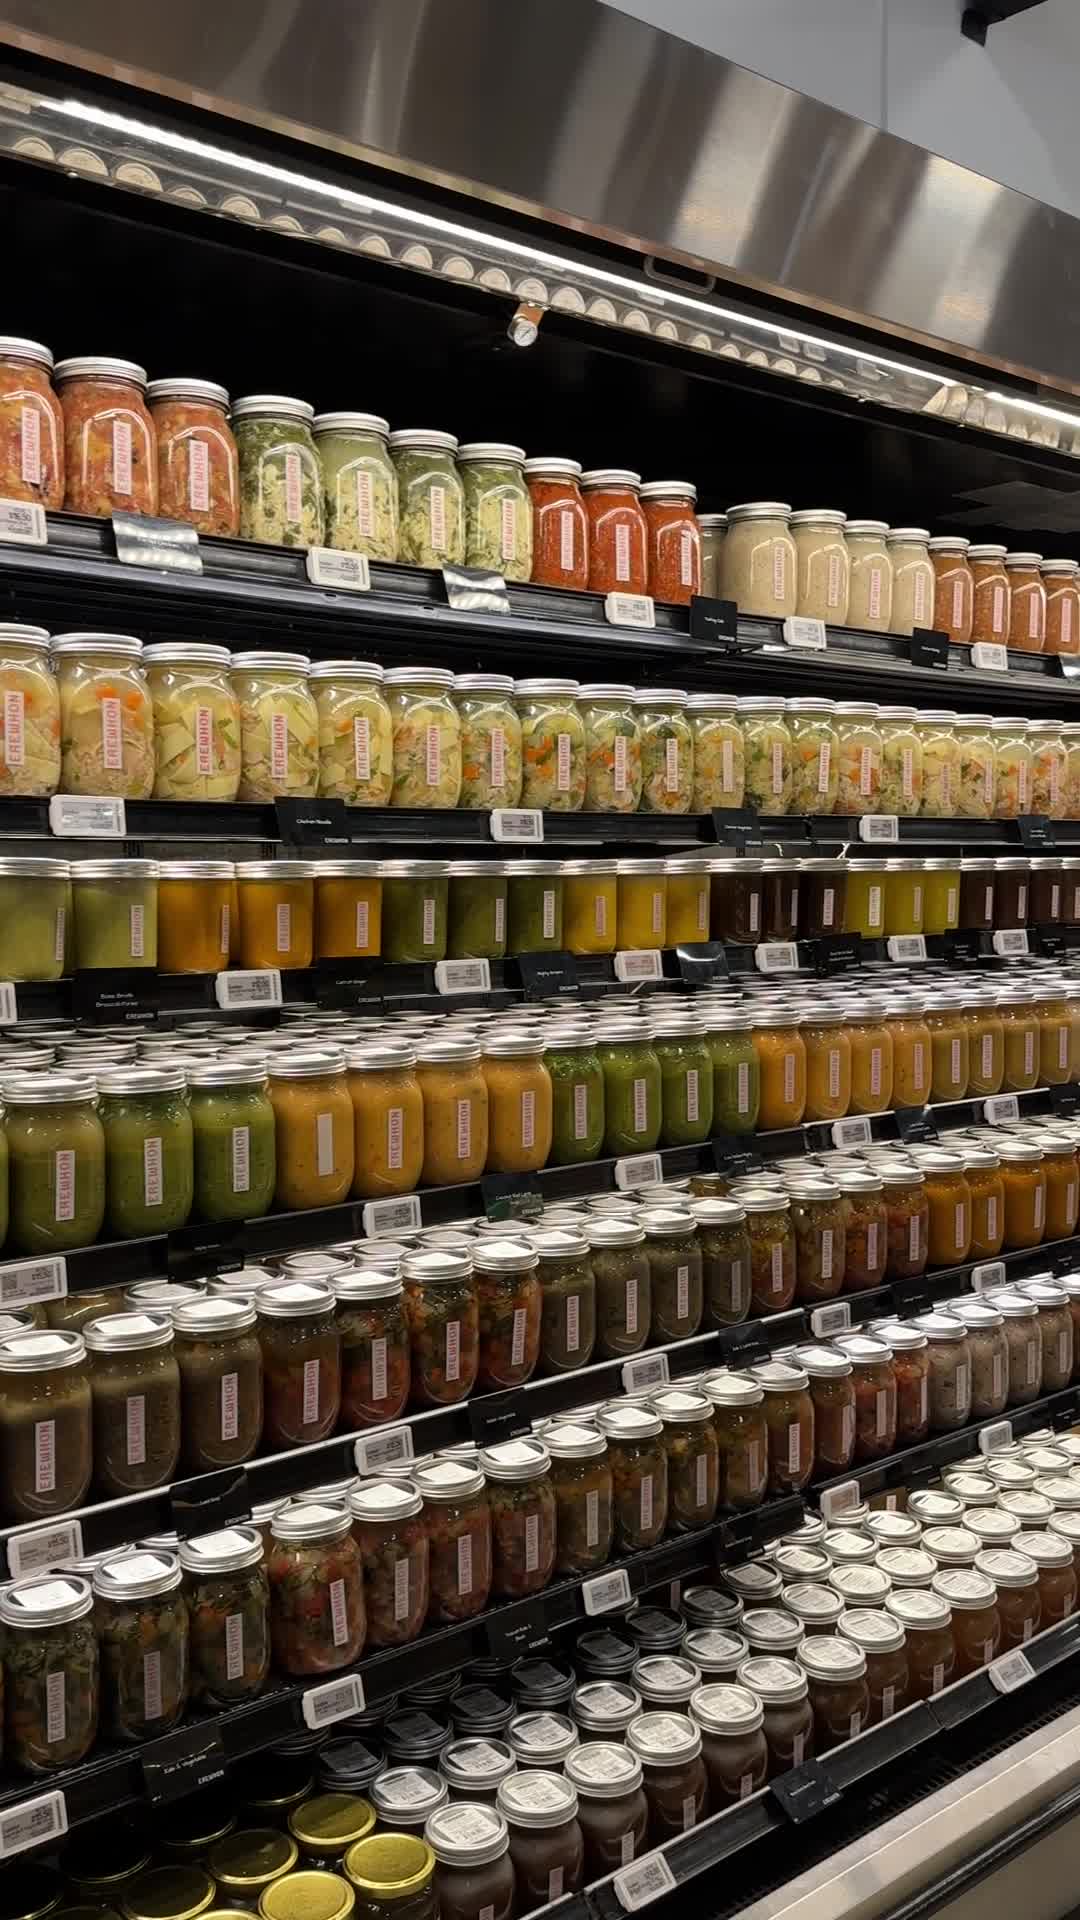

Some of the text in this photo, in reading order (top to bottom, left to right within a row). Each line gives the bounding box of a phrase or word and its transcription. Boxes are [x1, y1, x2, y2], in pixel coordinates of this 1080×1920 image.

[115, 422, 130, 493] EREWHON
[191, 441, 206, 509] EREWHON
[288, 456, 300, 520] EREWHON
[359, 472, 371, 535] EREWHON
[433, 488, 443, 548] EREWHON
[504, 500, 513, 558] EREWHON
[7, 694, 22, 764] EREWHON
[105, 700, 120, 767] EREWHON
[199, 709, 211, 772] EREWHON
[274, 716, 285, 776] EREWHON
[357, 719, 368, 778] EREWHON
[429, 727, 438, 783] EREWHON
[493, 730, 502, 784] EREWHON
[559, 737, 569, 788] EREWHON
[616, 738, 625, 789] EREWHON
[668, 741, 677, 790] EREWHON
[133, 907, 142, 954] EREWHON
[425, 901, 434, 943] EREWHON
[235, 1128, 247, 1190] EREWHON
[390, 1110, 400, 1166] EREWHON
[459, 1102, 469, 1156] EREWHON
[58, 1152, 73, 1219] EREWHON
[146, 1139, 161, 1204] EREWHON
[448, 1323, 458, 1379] EREWHON
[514, 1311, 524, 1363] EREWHON
[568, 1298, 578, 1349] EREWHON
[224, 1375, 236, 1438] EREWHON
[305, 1362, 317, 1422] EREWHON
[38, 1422, 53, 1490] EREWHON
[790, 1425, 799, 1471] EREWHON
[332, 1581, 346, 1644] EREWHON
[228, 1615, 241, 1678] EREWHON
